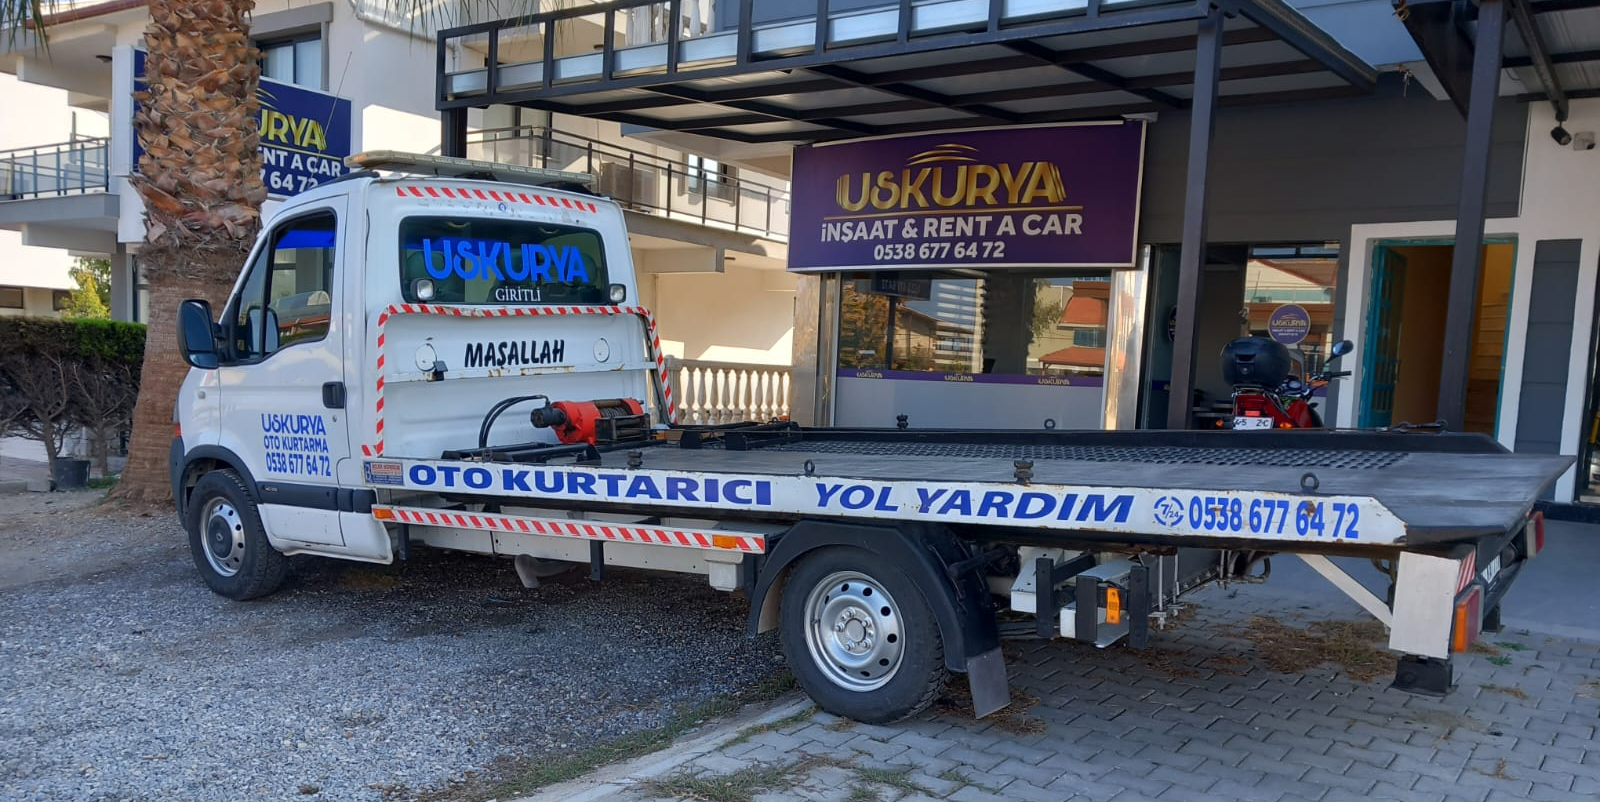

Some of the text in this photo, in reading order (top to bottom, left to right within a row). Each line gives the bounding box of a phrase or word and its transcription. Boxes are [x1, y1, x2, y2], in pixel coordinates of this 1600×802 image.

[291, 154, 303, 171] A
[306, 156, 341, 177] CAR
[270, 171, 294, 191] 64
[837, 161, 1067, 211] USKURYA
[901, 218, 918, 238] &
[923, 216, 993, 238] RENT
[995, 216, 1016, 236] A
[1022, 213, 1083, 235] CAR
[422, 238, 590, 284] USKURYA
[874, 241, 1005, 261] 0538 677 64 72
[464, 339, 566, 369] MAŞALLAH
[261, 413, 327, 436] USKURYA
[263, 435, 329, 453] OTO KURTARMA
[266, 451, 331, 477] 0538 677 64 72
[409, 463, 1360, 539] OTO KURTARICI YOL YARDIM 7/24 0538 677 64 72
